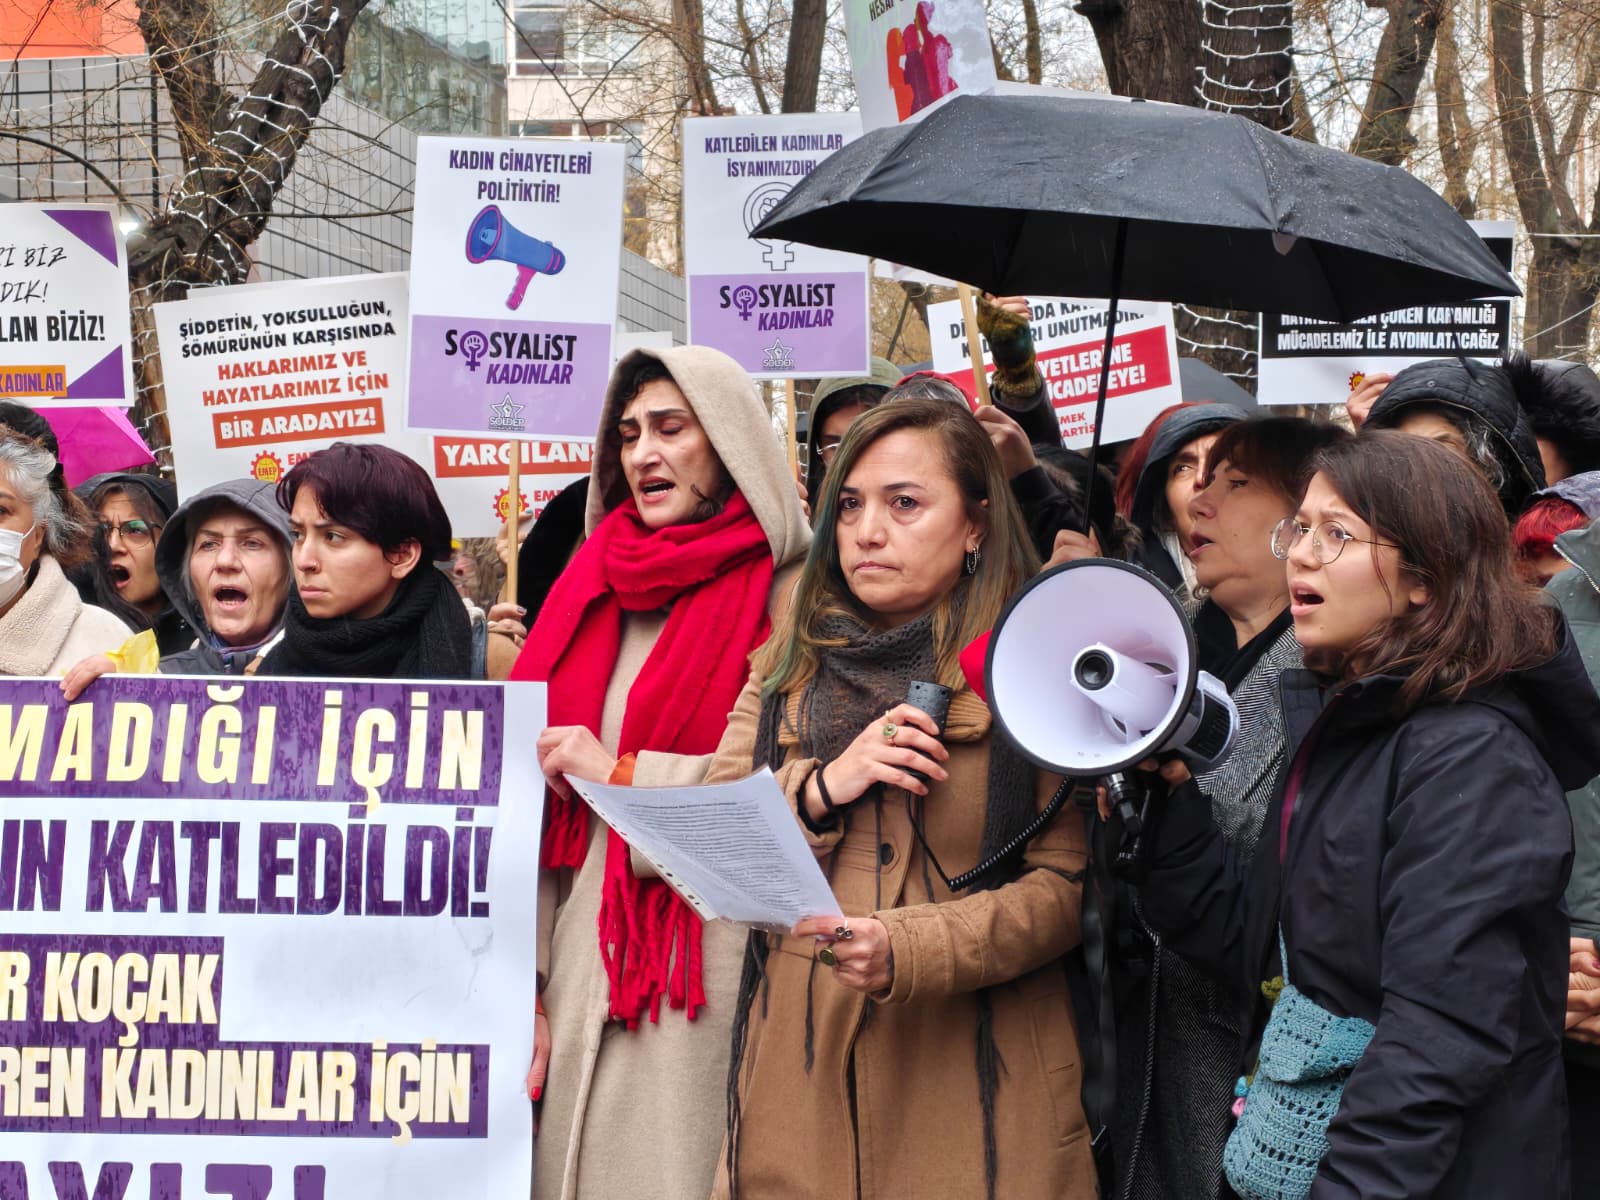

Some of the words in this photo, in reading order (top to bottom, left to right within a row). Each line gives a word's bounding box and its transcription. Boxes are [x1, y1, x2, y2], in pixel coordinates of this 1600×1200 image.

[705, 133, 777, 153] KATLEDİLEN
[781, 134, 843, 152] KADINLAR
[449, 150, 494, 171] KADIN
[500, 148, 592, 175] CİNAYETLERİ
[477, 178, 560, 203] POLİTİKTİR!
[24, 243, 68, 268] BİZ
[46, 309, 106, 341] BİZİZ!
[179, 313, 258, 341] ŞİDDETİN,
[262, 300, 392, 327] YOKSULLUĞUN,
[758, 309, 834, 331] KADINLAR
[182, 330, 287, 358] SÖMÜRÜNÜN
[293, 322, 396, 346] KARŞISINDA
[1278, 328, 1363, 350] MÜCADELEMİZ
[1366, 328, 1386, 349] İLE
[217, 353, 337, 381] HAKLARIMIZ
[342, 351, 367, 368] VE
[486, 363, 573, 384] KADINLAR
[202, 377, 341, 407] HAYATLARIMIZ
[347, 370, 389, 396] İÇİN
[220, 415, 255, 440] BİR
[260, 406, 377, 436] ARADAYIZ!
[317, 690, 485, 811] İÇİN
[85, 804, 493, 917] KATLEDİLDİ!
[43, 953, 220, 1047] KOÇAK
[101, 1048, 357, 1122] KADINLAR
[369, 1038, 471, 1145] İÇİN
